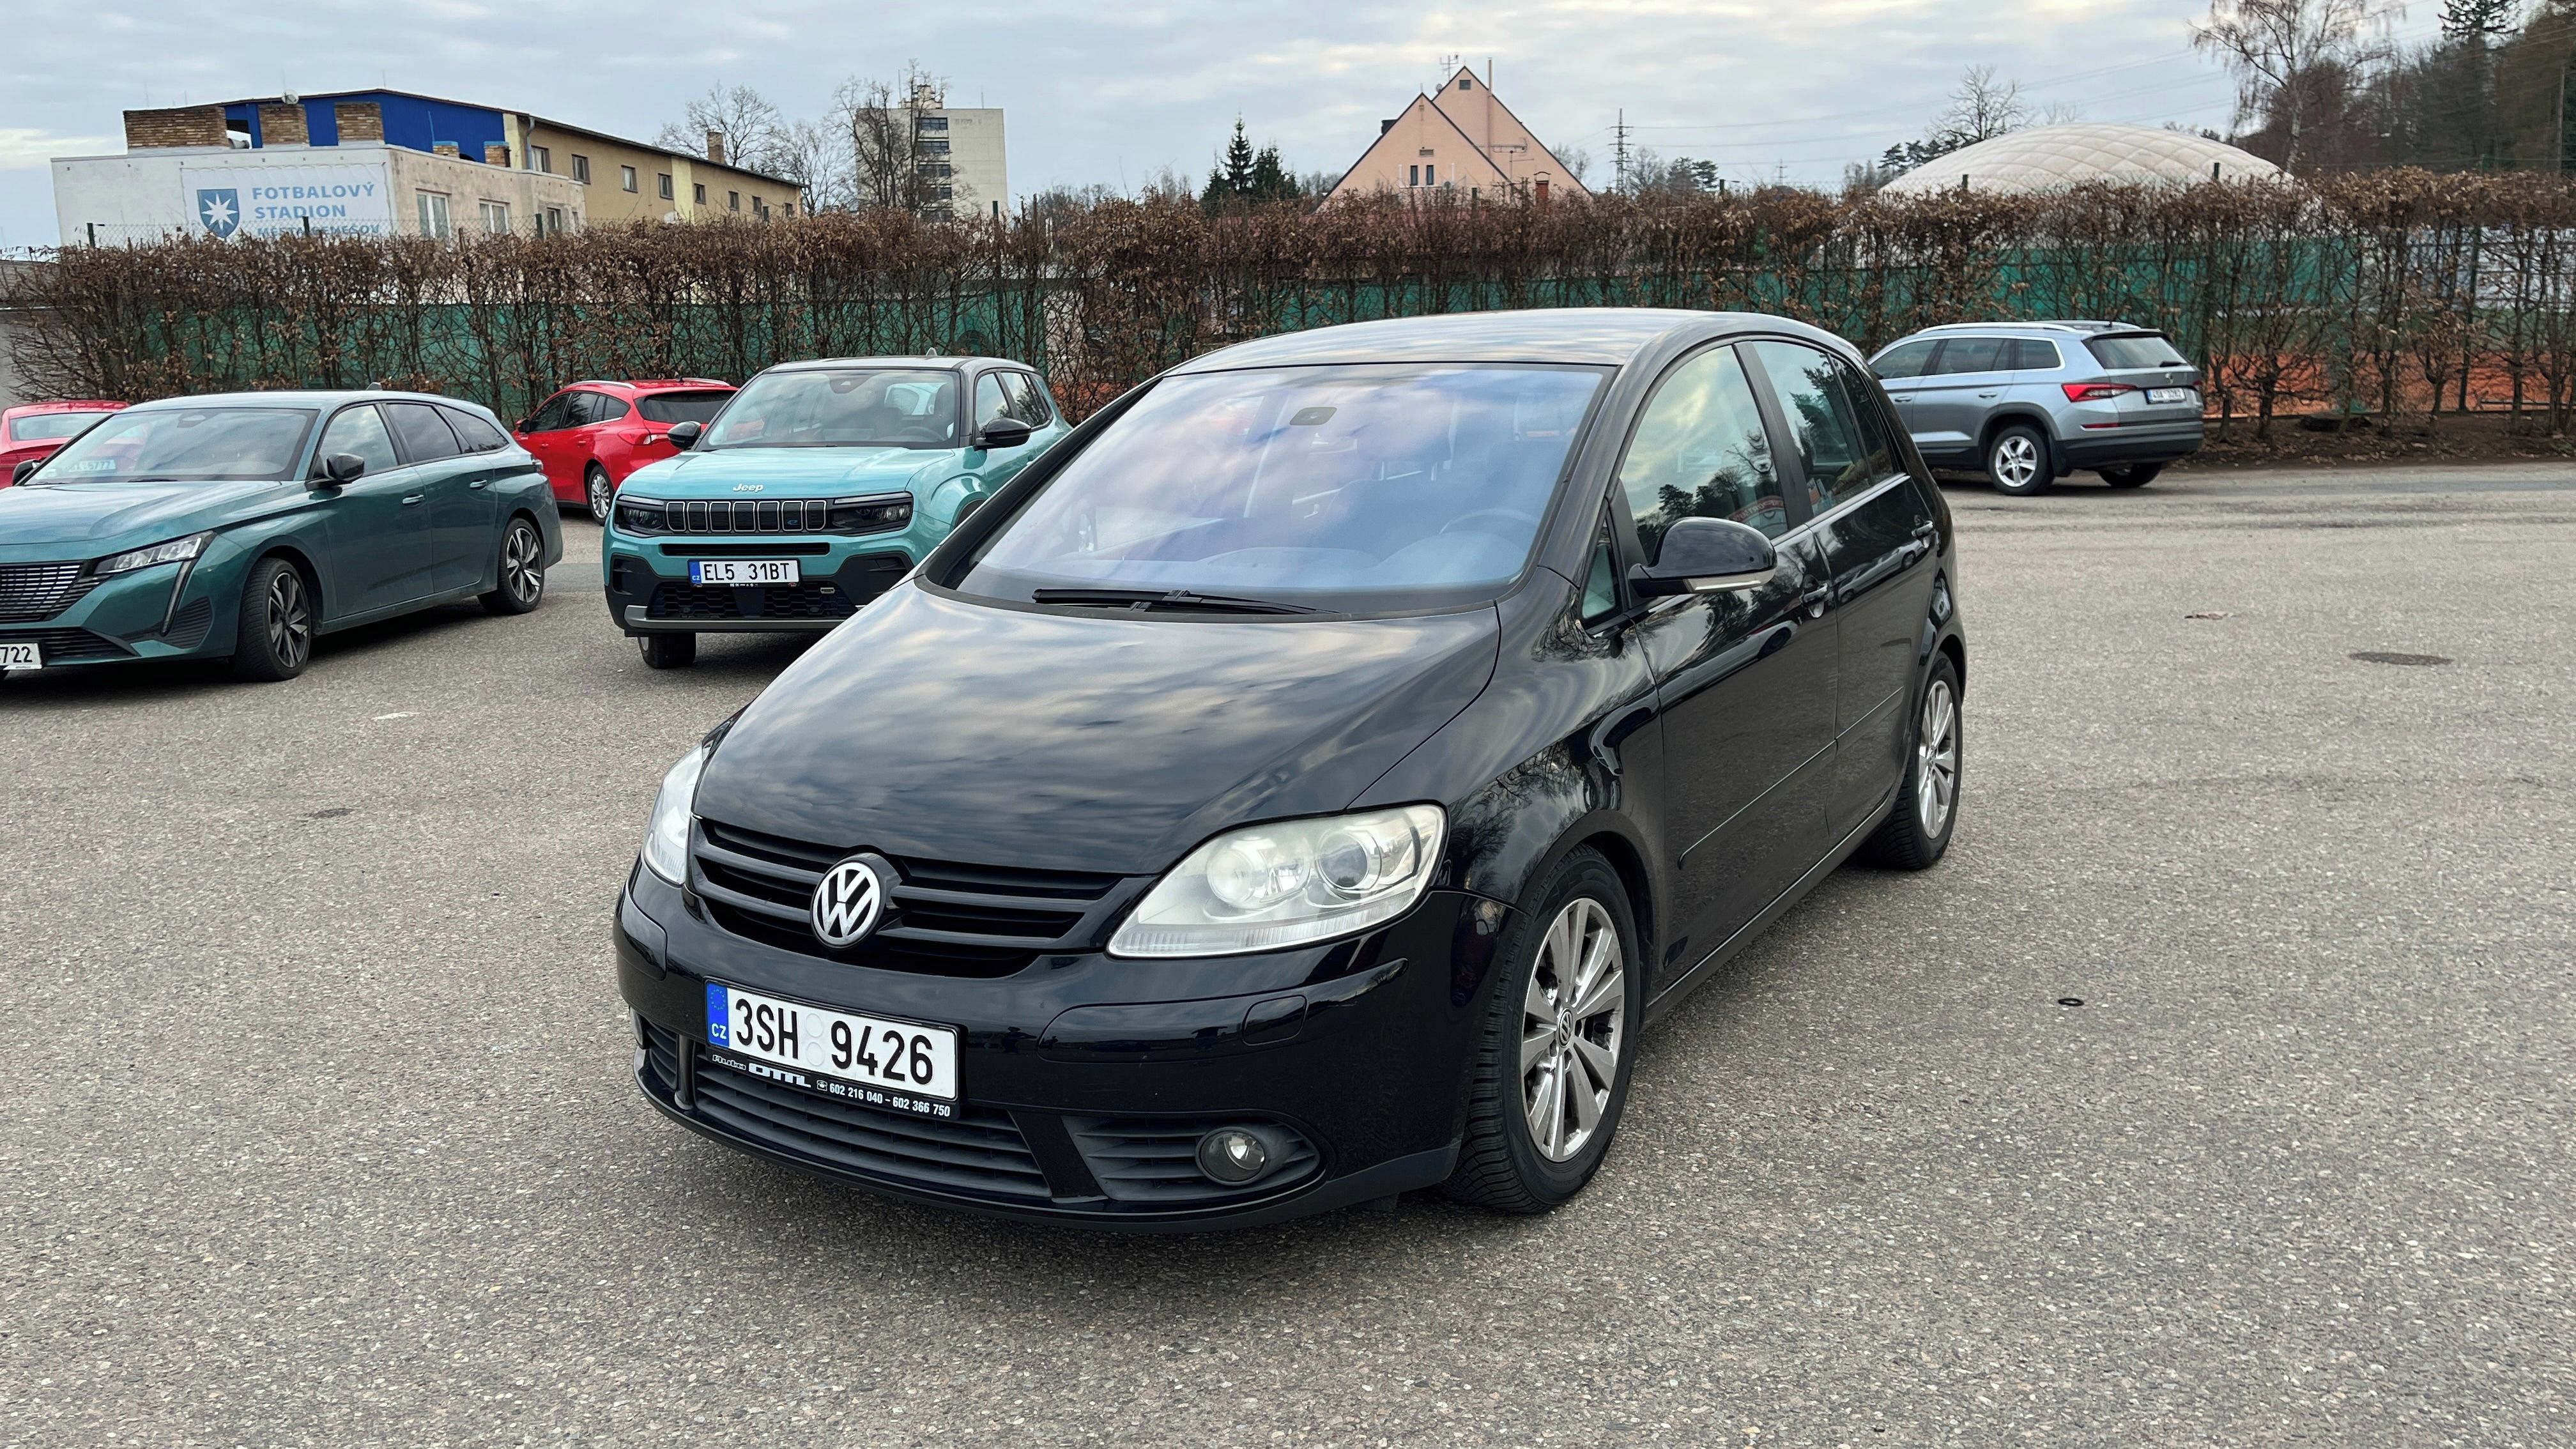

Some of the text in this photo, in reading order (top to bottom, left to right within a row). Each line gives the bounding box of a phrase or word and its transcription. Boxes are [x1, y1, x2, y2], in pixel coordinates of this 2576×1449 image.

[252, 181, 374, 199] FOTBALOVÝ
[254, 204, 346, 219] STADION
[733, 484, 763, 493] Jeep
[703, 562, 790, 581] EL5 31BT
[0, 646, 33, 663] 722
[813, 862, 880, 946] VW
[711, 1023, 727, 1039] CZ
[735, 998, 933, 1085] 3SH 9426
[829, 1083, 845, 1096] 602
[848, 1087, 864, 1100] 216
[866, 1091, 883, 1104] 040
[893, 1096, 909, 1110] 602
[912, 1100, 930, 1113] 366
[933, 1103, 951, 1117] 750
